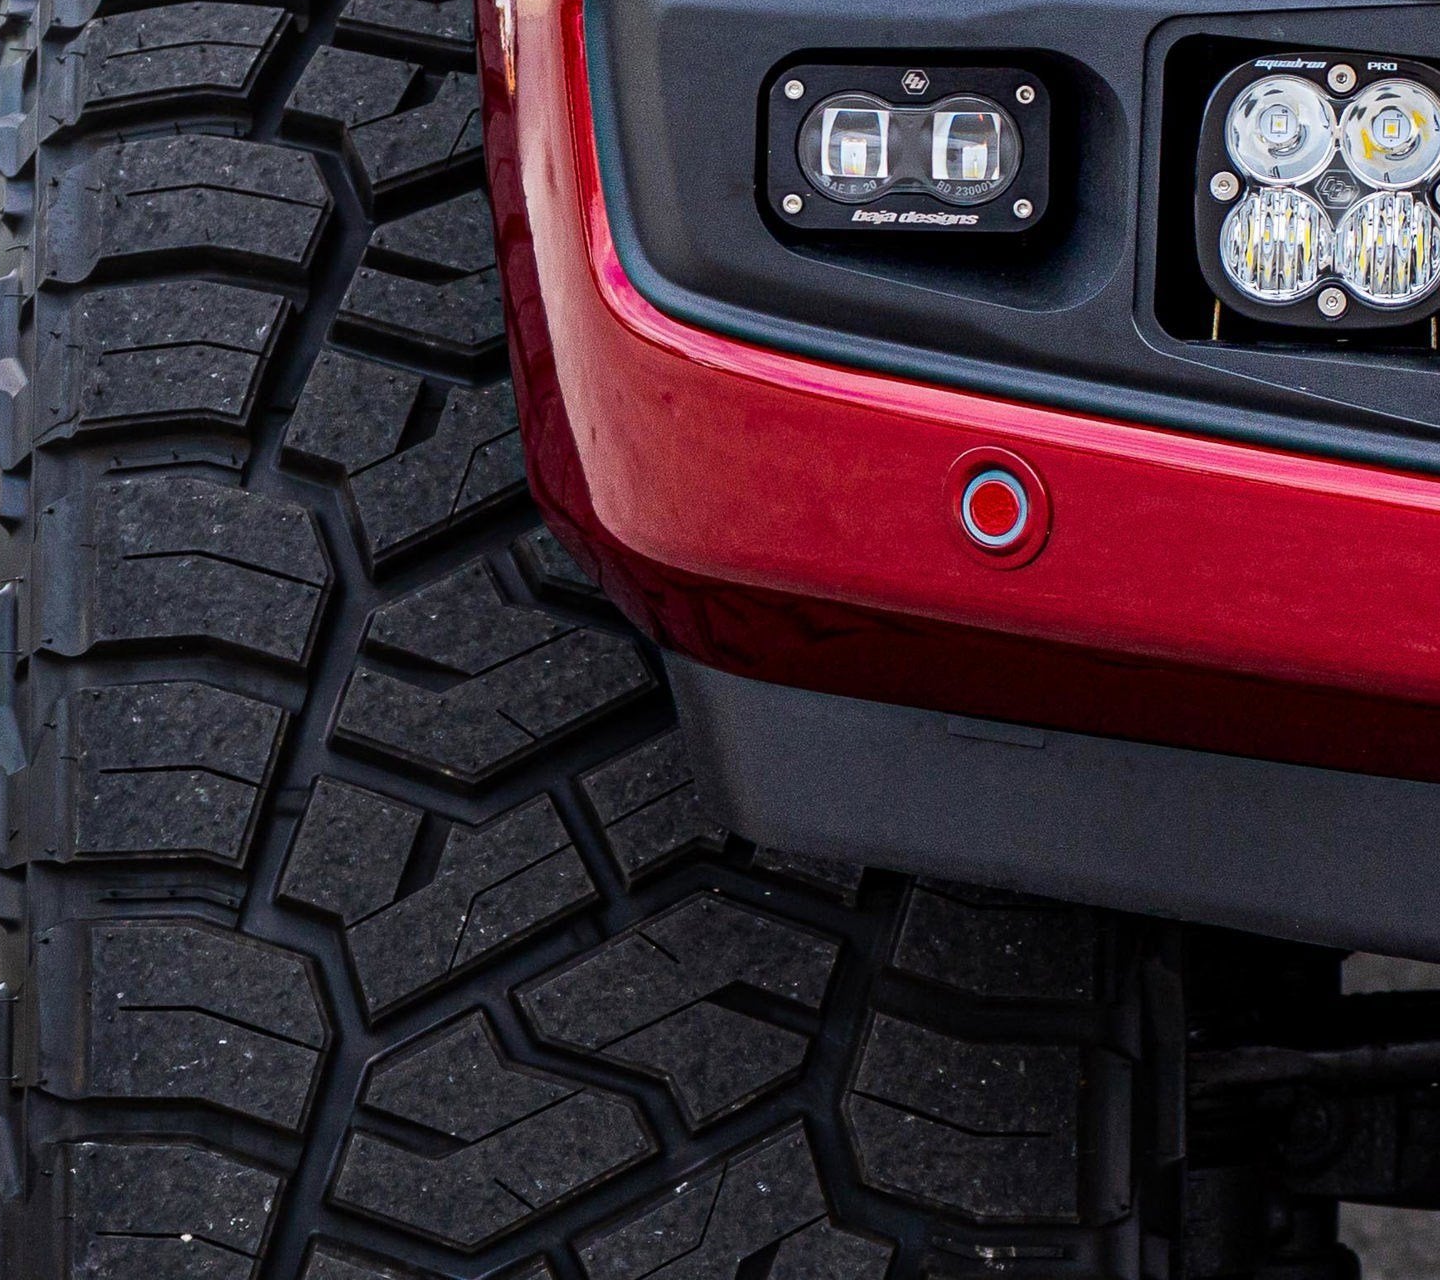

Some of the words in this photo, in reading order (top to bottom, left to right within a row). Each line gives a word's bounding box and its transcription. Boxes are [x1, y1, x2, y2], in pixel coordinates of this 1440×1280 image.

[1254, 57, 1327, 71] squadron
[1367, 61, 1398, 71] PRO
[862, 179, 878, 193] 20
[936, 180, 951, 194] BD
[851, 209, 898, 225] baja
[898, 211, 979, 226] designs
